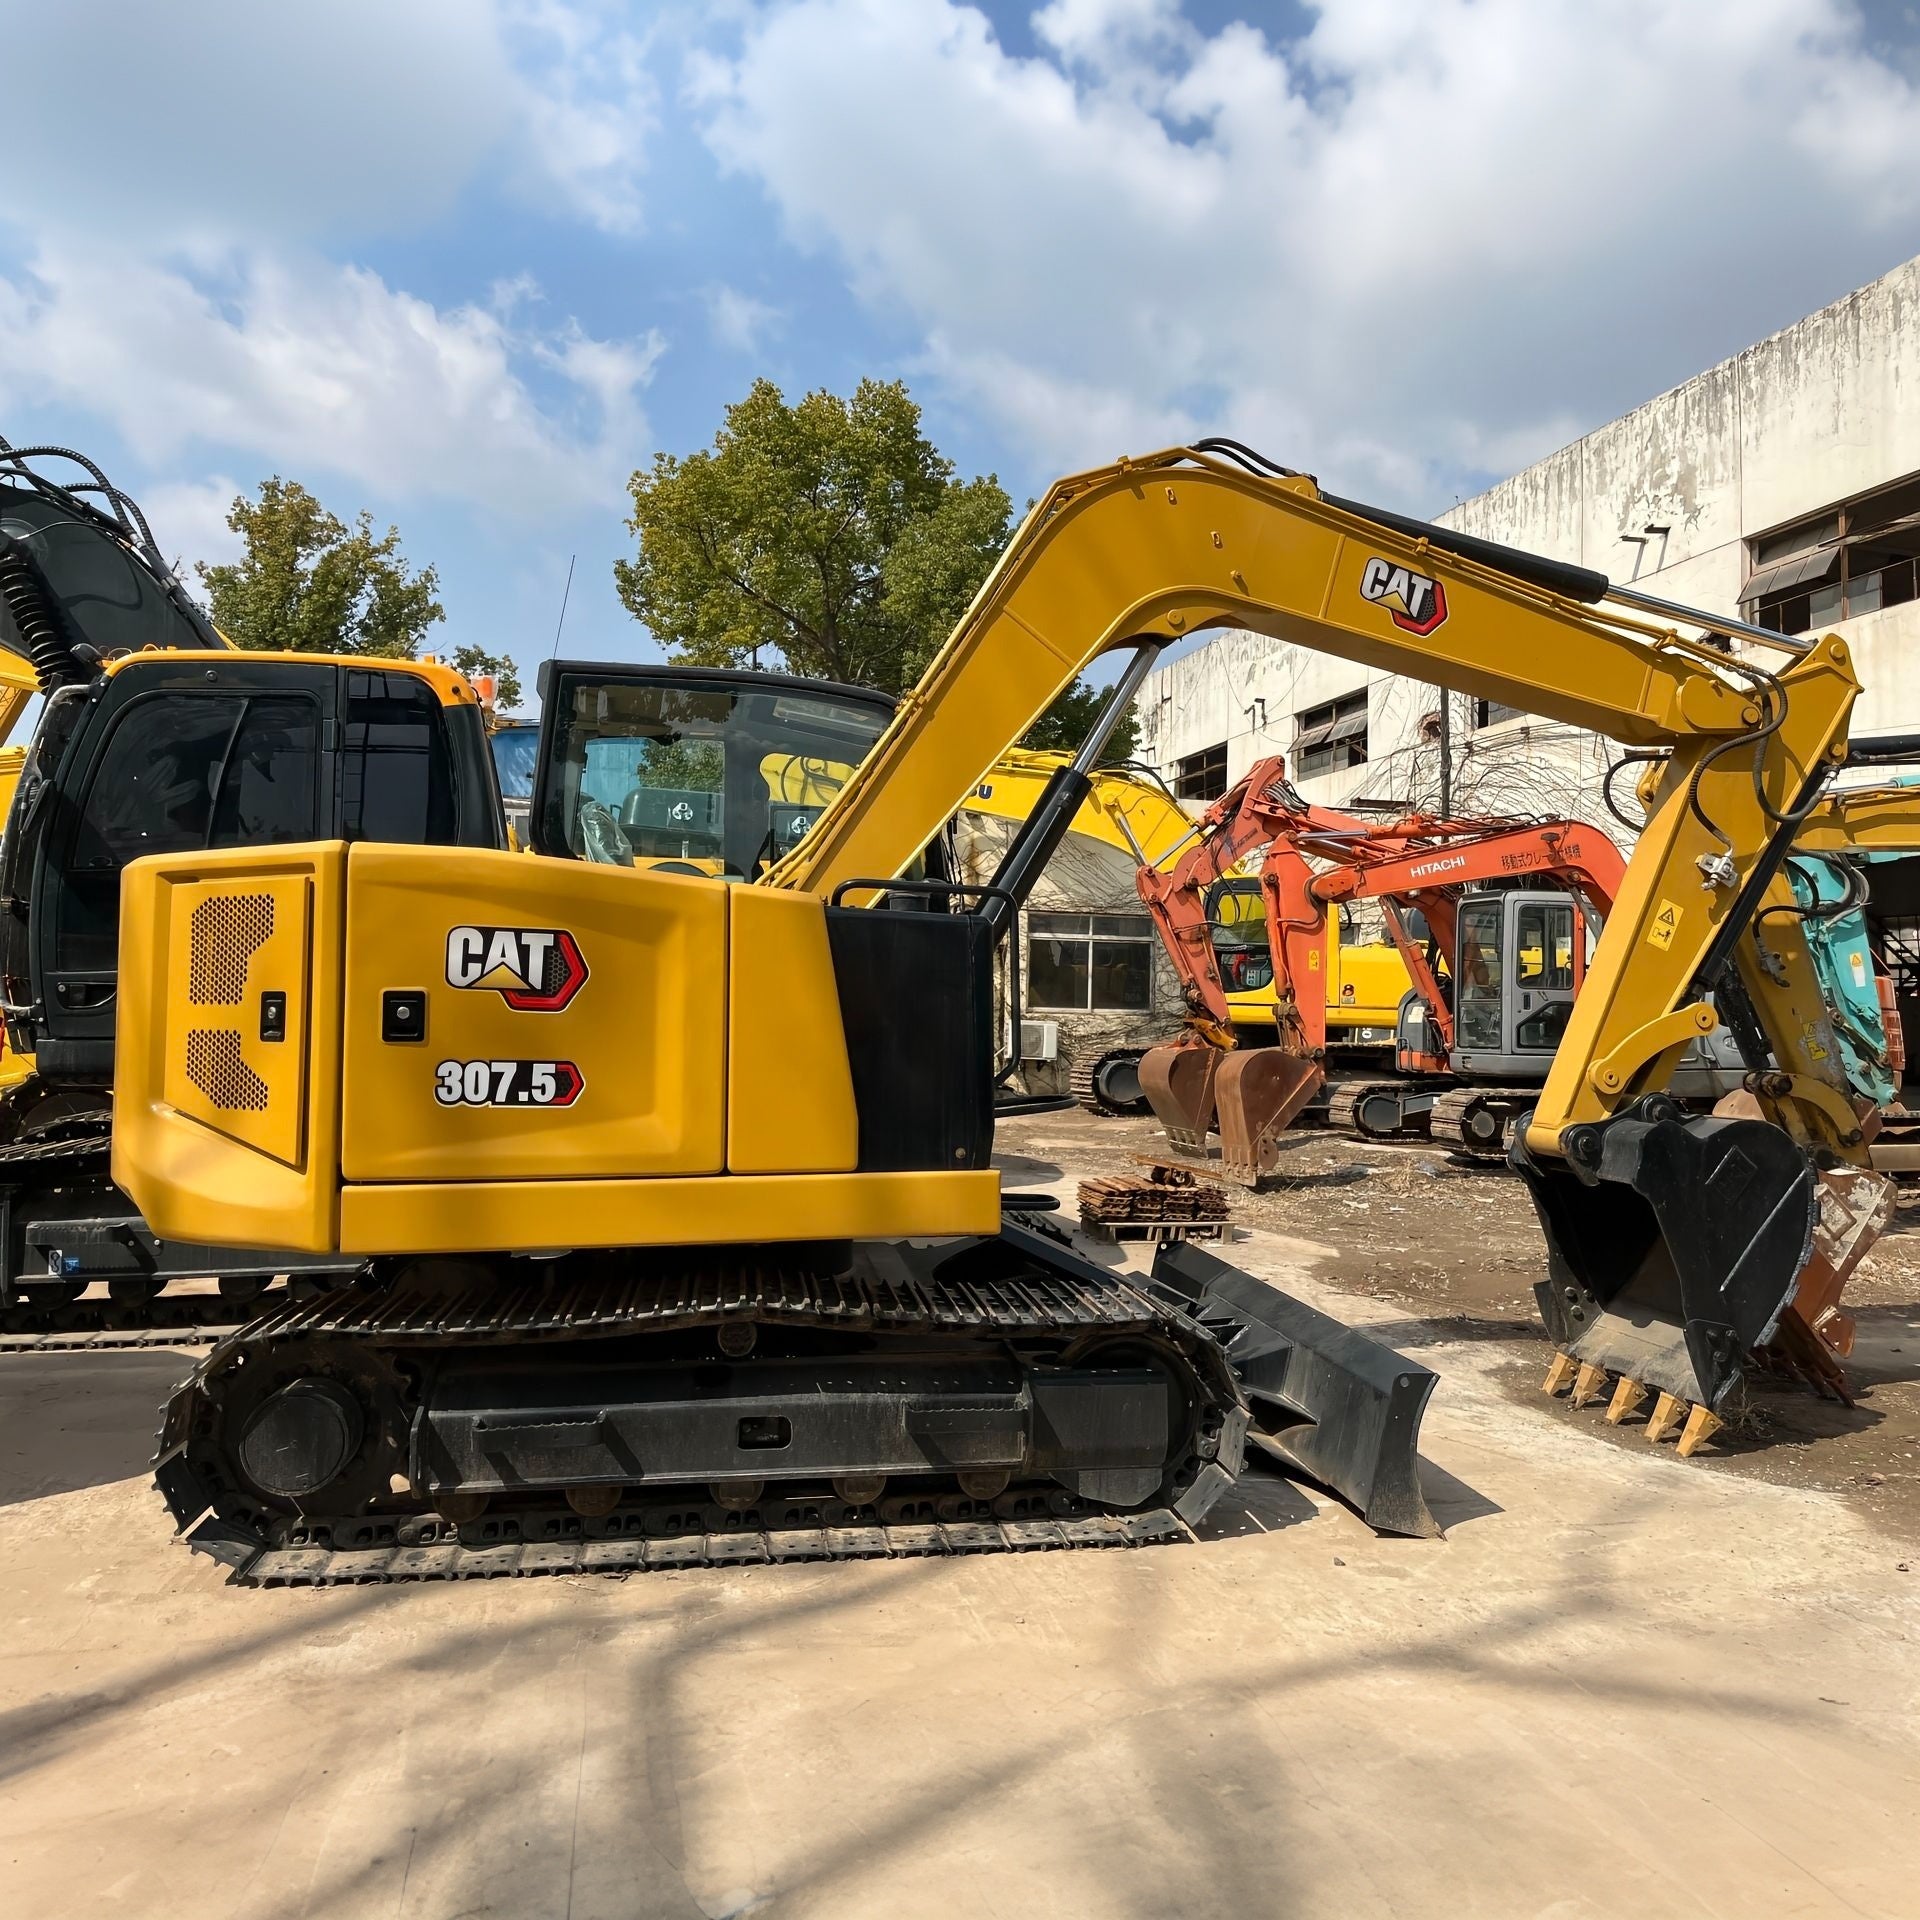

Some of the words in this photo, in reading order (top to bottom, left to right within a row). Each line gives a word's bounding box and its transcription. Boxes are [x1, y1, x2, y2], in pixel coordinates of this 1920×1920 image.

[1361, 558, 1433, 618] CAT
[1410, 856, 1465, 877] HITACHI
[448, 927, 554, 990] CAT
[437, 1061, 556, 1102] 307.5
